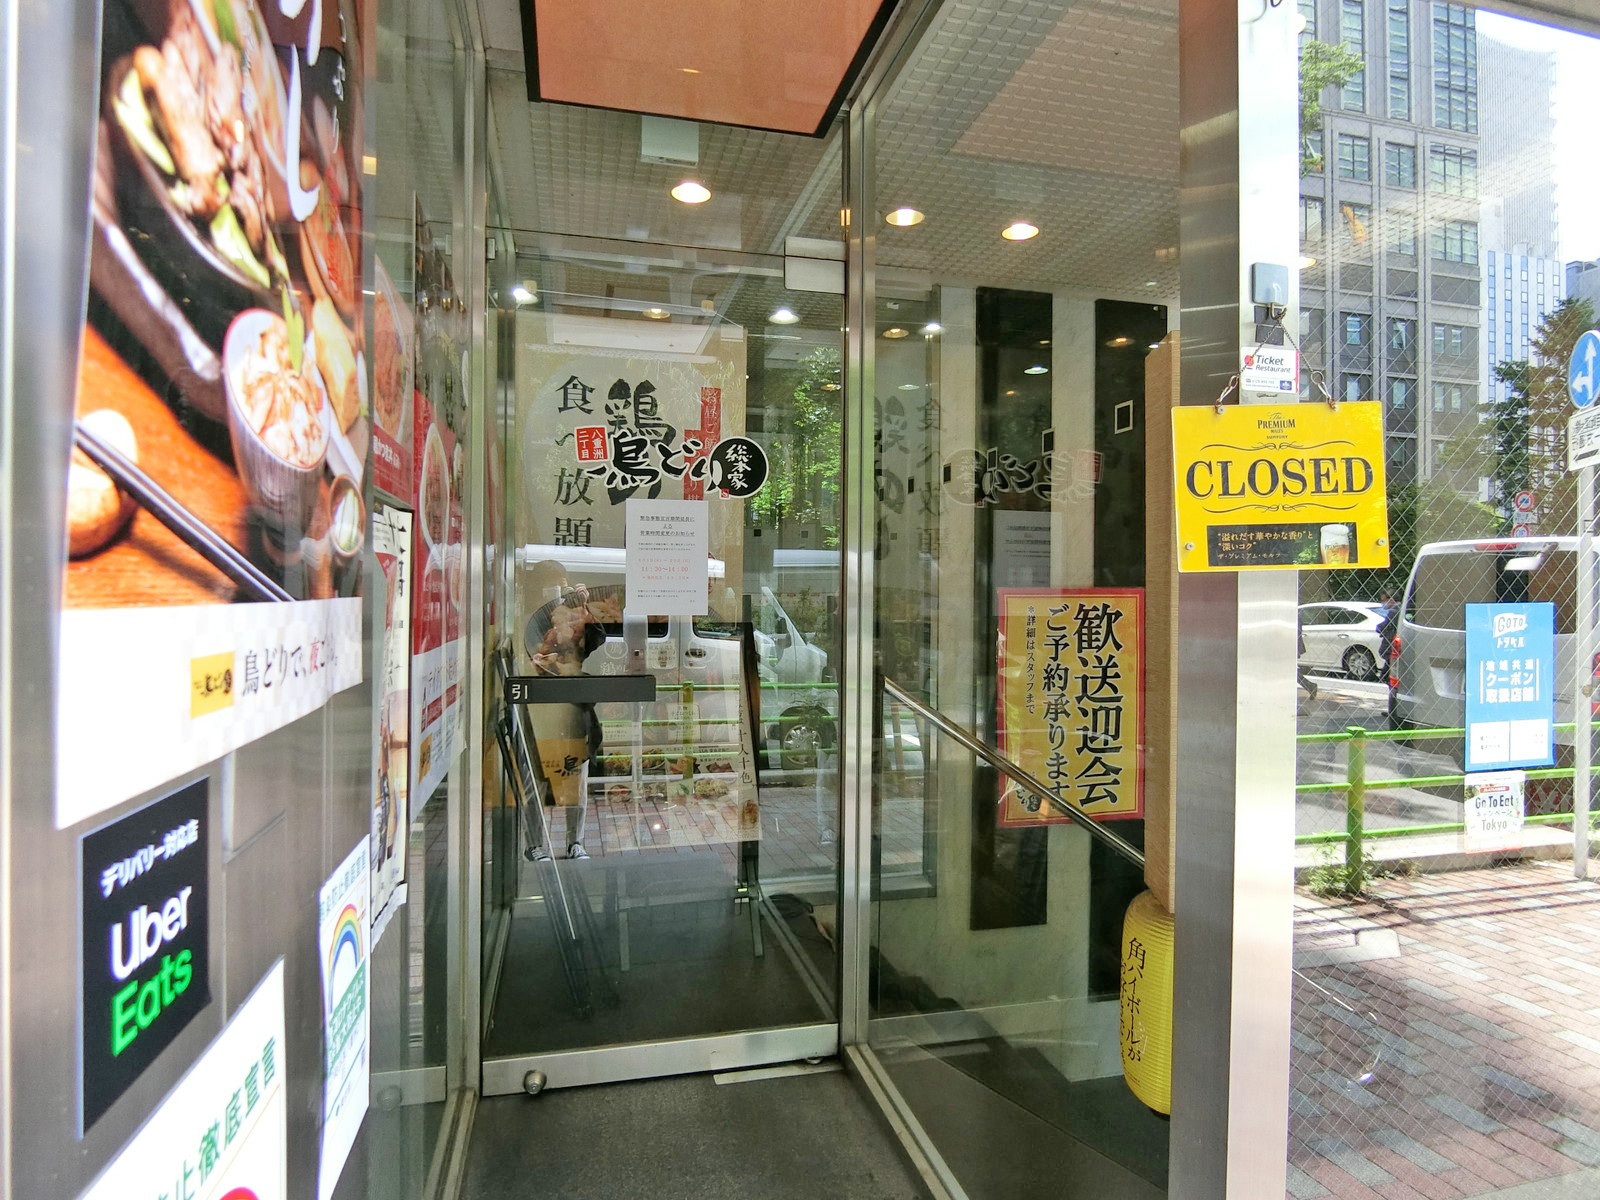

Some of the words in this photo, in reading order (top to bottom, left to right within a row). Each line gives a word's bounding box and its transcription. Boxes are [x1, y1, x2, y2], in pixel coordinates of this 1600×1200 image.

[1255, 364, 1291, 373] Restaurant
[1256, 355, 1284, 366] Ticket
[1257, 419, 1296, 429] PREMIUM
[578, 430, 590, 459] 二丁目
[592, 429, 604, 460] 八重洲
[586, 434, 723, 493] 鳥どり
[725, 443, 752, 490] 総本家
[1186, 457, 1375, 499] CLOSED
[1496, 637, 1525, 649] トラベル
[511, 683, 528, 700] 引
[1485, 671, 1534, 686] クーポン
[1073, 602, 1123, 807] 歓送迎会
[1475, 798, 1486, 809] Go
[1488, 795, 1497, 808] To
[1500, 794, 1514, 807] Eat
[1481, 819, 1508, 832] Tokyo
[99, 818, 200, 898] デリバリー対応店
[109, 885, 193, 981] Uber
[111, 948, 193, 1057] Eats
[1127, 937, 1146, 1062] 角ハイボールが
[157, 1036, 277, 1200] 止徹底宣言
